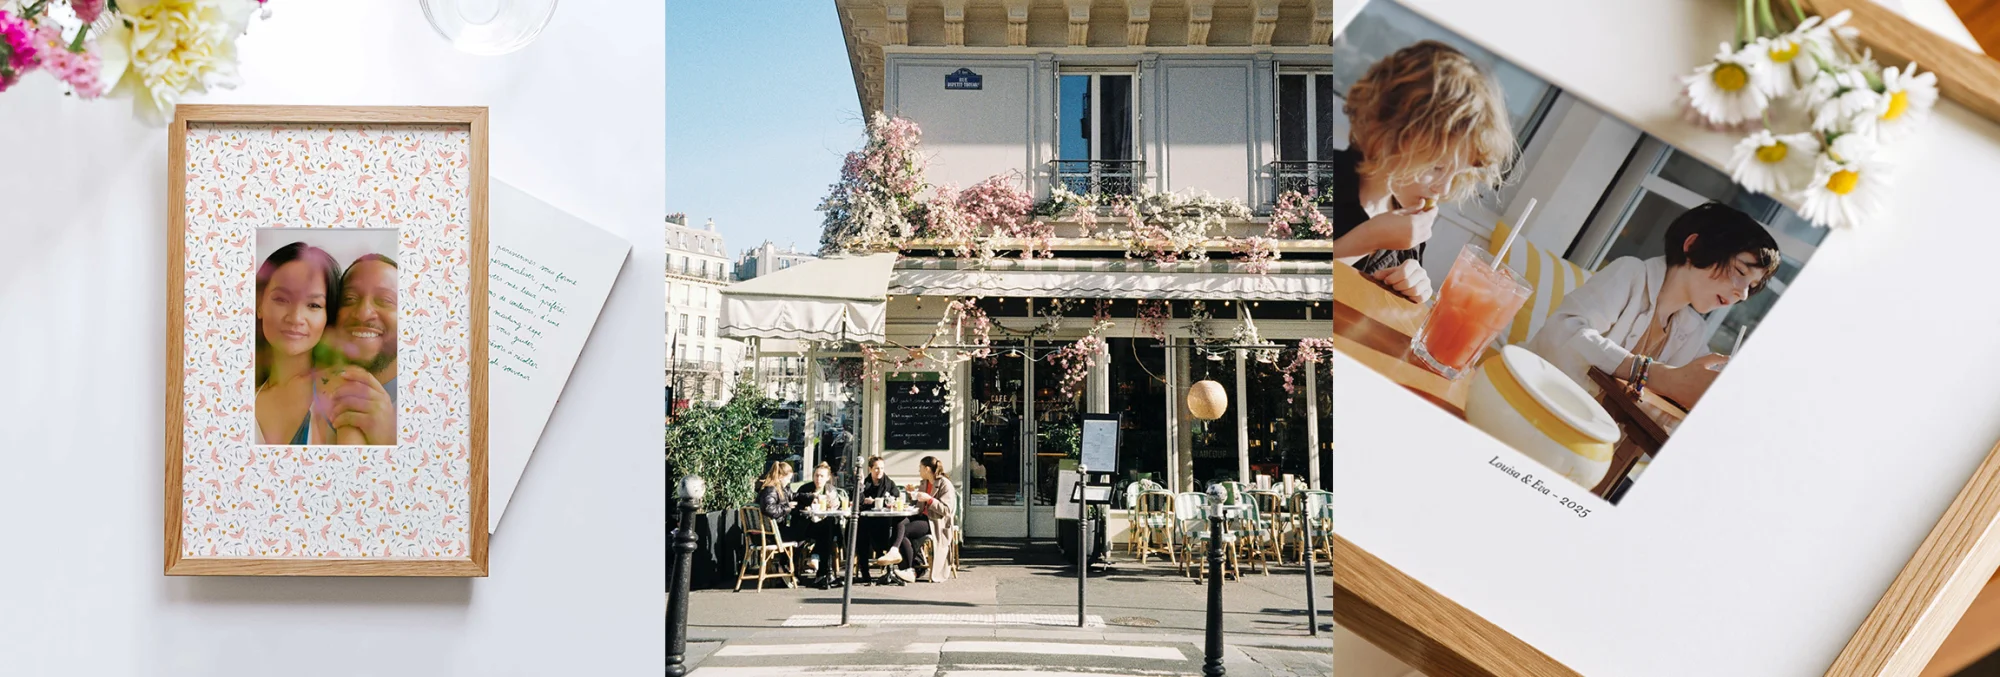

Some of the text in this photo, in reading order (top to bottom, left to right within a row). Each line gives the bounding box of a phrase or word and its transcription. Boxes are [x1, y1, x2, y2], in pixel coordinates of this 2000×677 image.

[1488, 456, 1520, 479] Louisa
[1521, 474, 1532, 484] &
[1531, 479, 1550, 495] Eva
[1560, 497, 1591, 518] 2025
